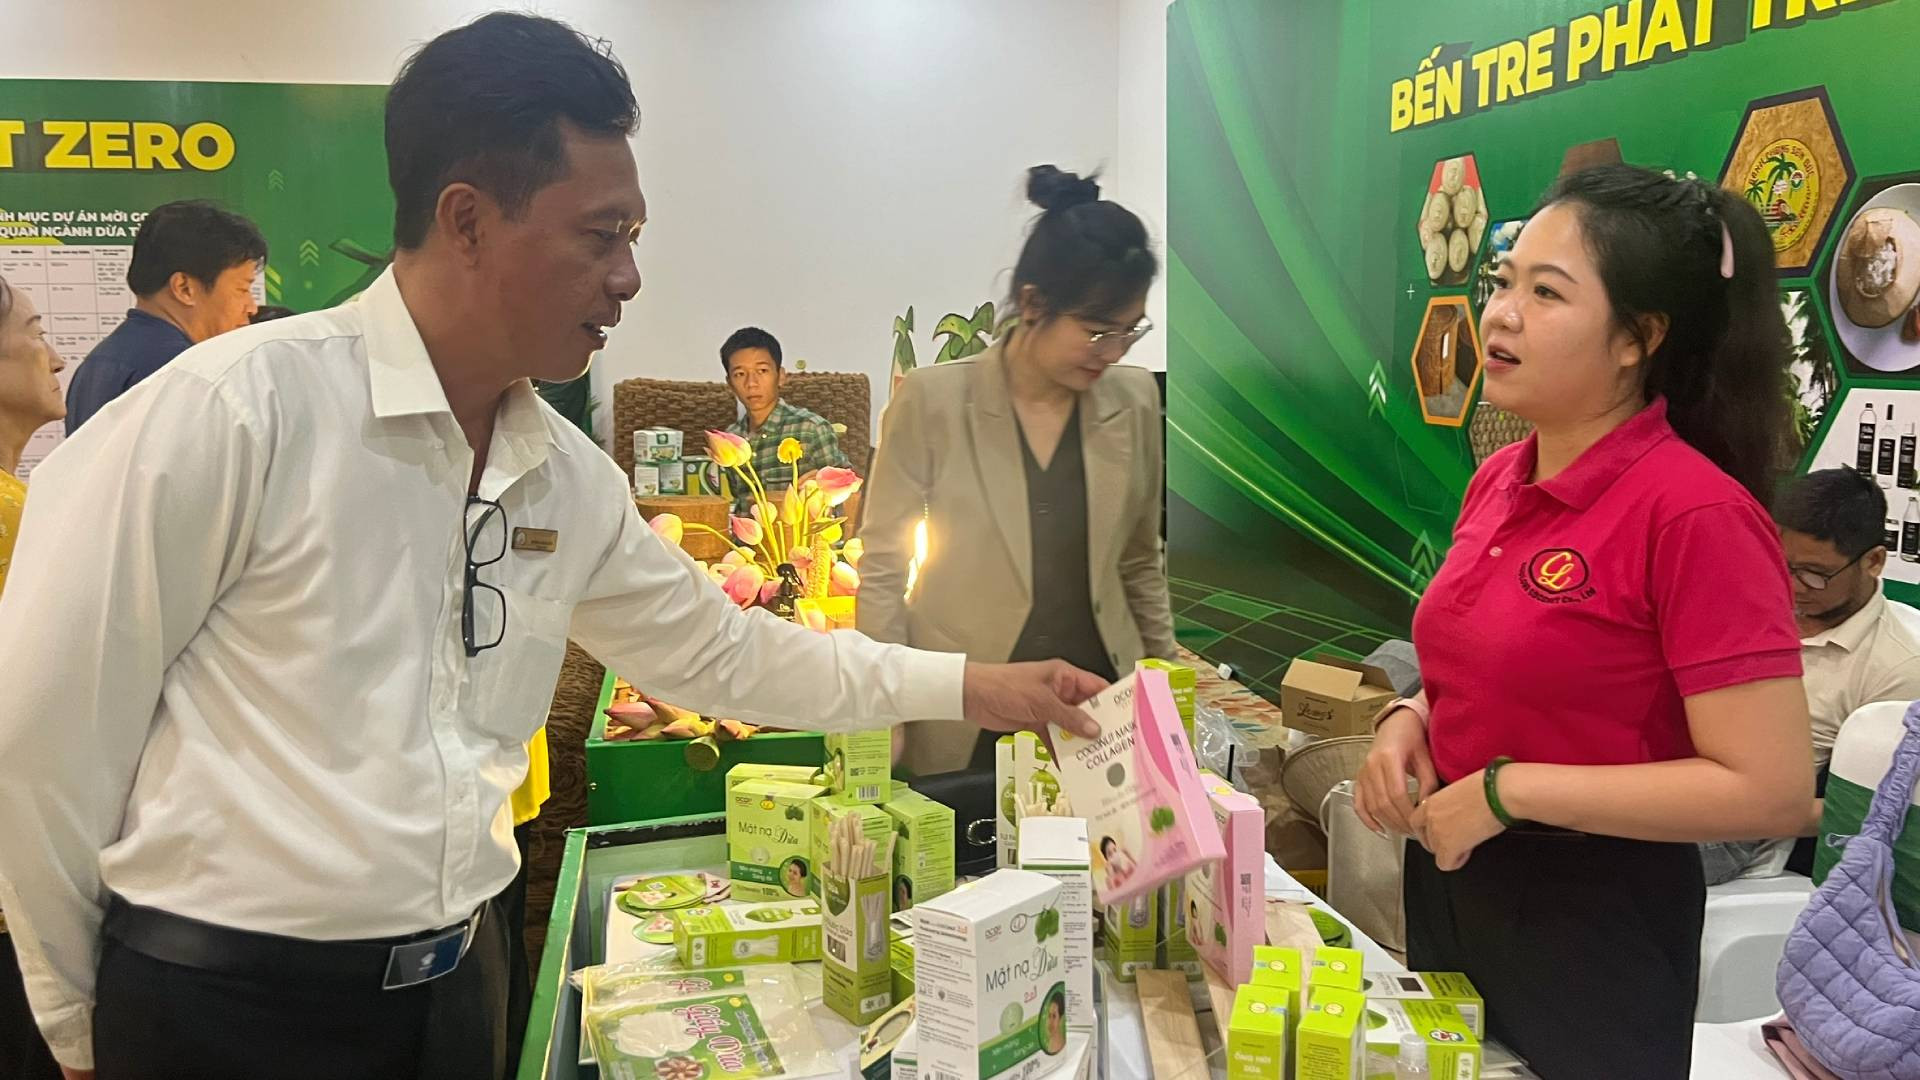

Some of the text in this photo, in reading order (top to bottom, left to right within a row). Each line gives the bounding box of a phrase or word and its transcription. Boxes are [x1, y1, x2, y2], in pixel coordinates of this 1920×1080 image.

[1391, 46, 1462, 133] BẾN
[1472, 27, 1555, 108] TRE
[43, 121, 236, 171] ZERO
[0, 226, 39, 238] QUAN
[42, 222, 93, 237] NGÀNH
[95, 224, 127, 237] DỪA
[17, 211, 50, 225] MỤC
[52, 210, 75, 226] DỰ
[77, 209, 98, 222] ÁN
[101, 210, 128, 222] MỜI
[1086, 736, 1136, 770] COLLAGEN
[985, 965, 1011, 993] Mặt
[1014, 959, 1029, 979] nạ
